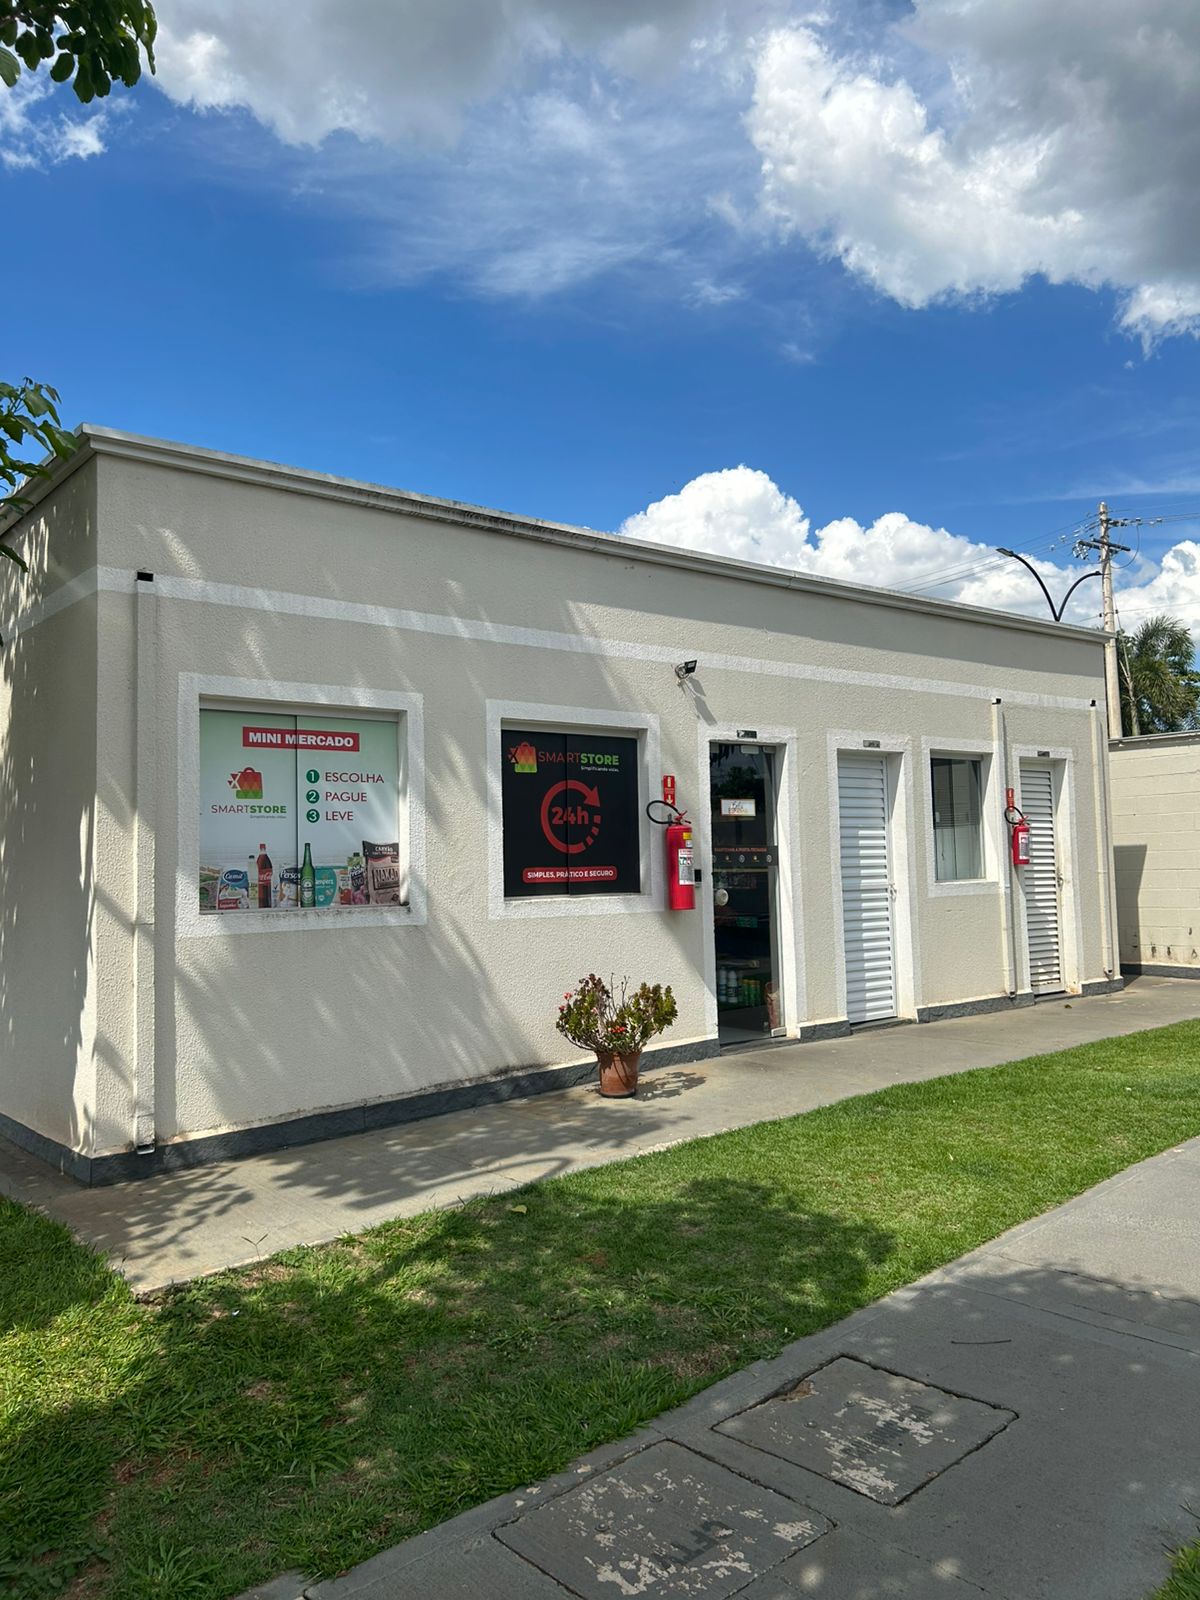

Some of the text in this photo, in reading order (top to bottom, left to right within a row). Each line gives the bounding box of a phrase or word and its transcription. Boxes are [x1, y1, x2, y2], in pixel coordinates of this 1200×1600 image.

[249, 732, 354, 747] MINI MERCADO
[538, 751, 620, 766] SMARTSTORE
[325, 772, 384, 784] ESCOLHA
[325, 791, 367, 802] PAGUE
[210, 804, 288, 814] SMARTSTORE
[325, 810, 354, 821] LEVE
[551, 806, 589, 825] 24h
